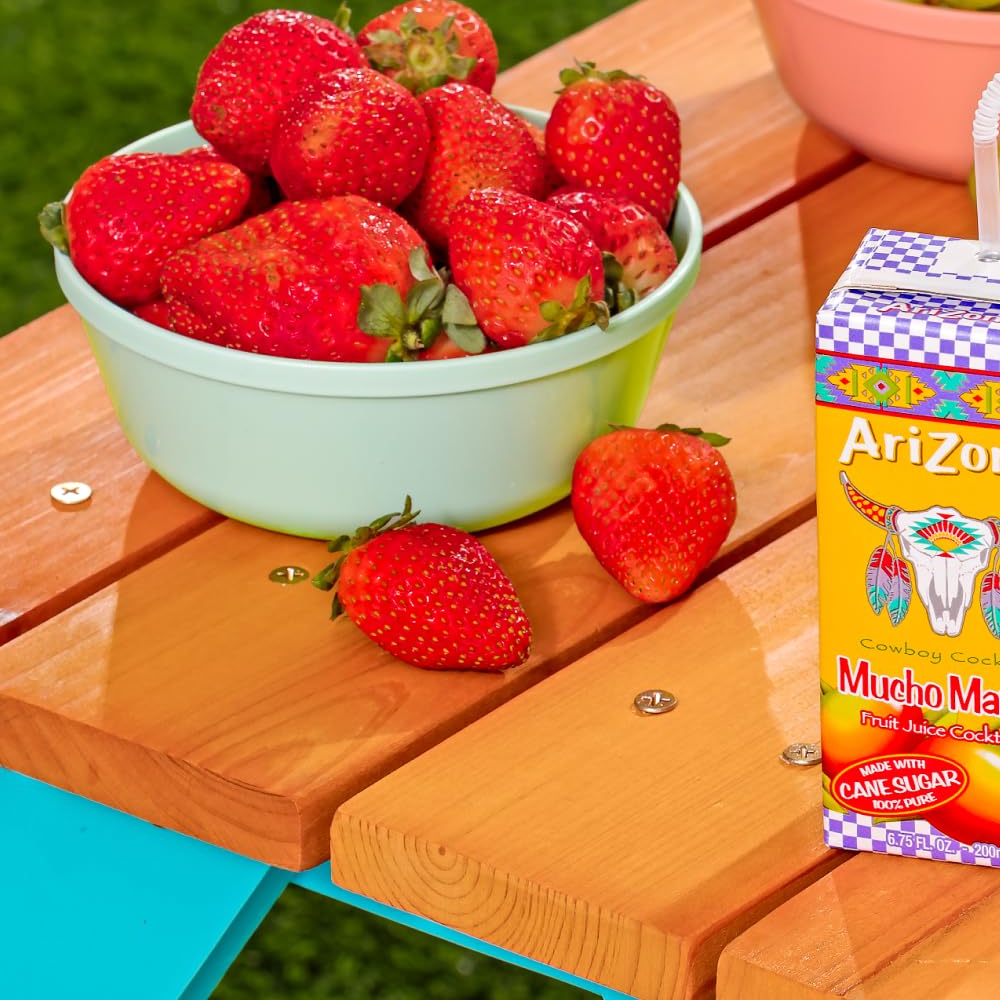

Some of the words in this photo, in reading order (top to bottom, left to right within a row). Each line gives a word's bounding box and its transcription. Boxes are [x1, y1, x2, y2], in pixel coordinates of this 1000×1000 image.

[859, 638, 942, 664] Cowboy
[837, 655, 944, 712] Mucho
[860, 711, 899, 731] Fruit
[902, 719, 947, 738] Juice
[859, 761, 893, 776] MADE
[894, 759, 926, 770] WITH
[839, 778, 892, 800] CANE
[893, 769, 961, 794] SUGAR
[872, 799, 903, 810] 100%
[904, 792, 937, 808] PURE
[886, 833, 913, 848] 6.75
[916, 836, 933, 850] FL.
[936, 839, 956, 854] OZ.
